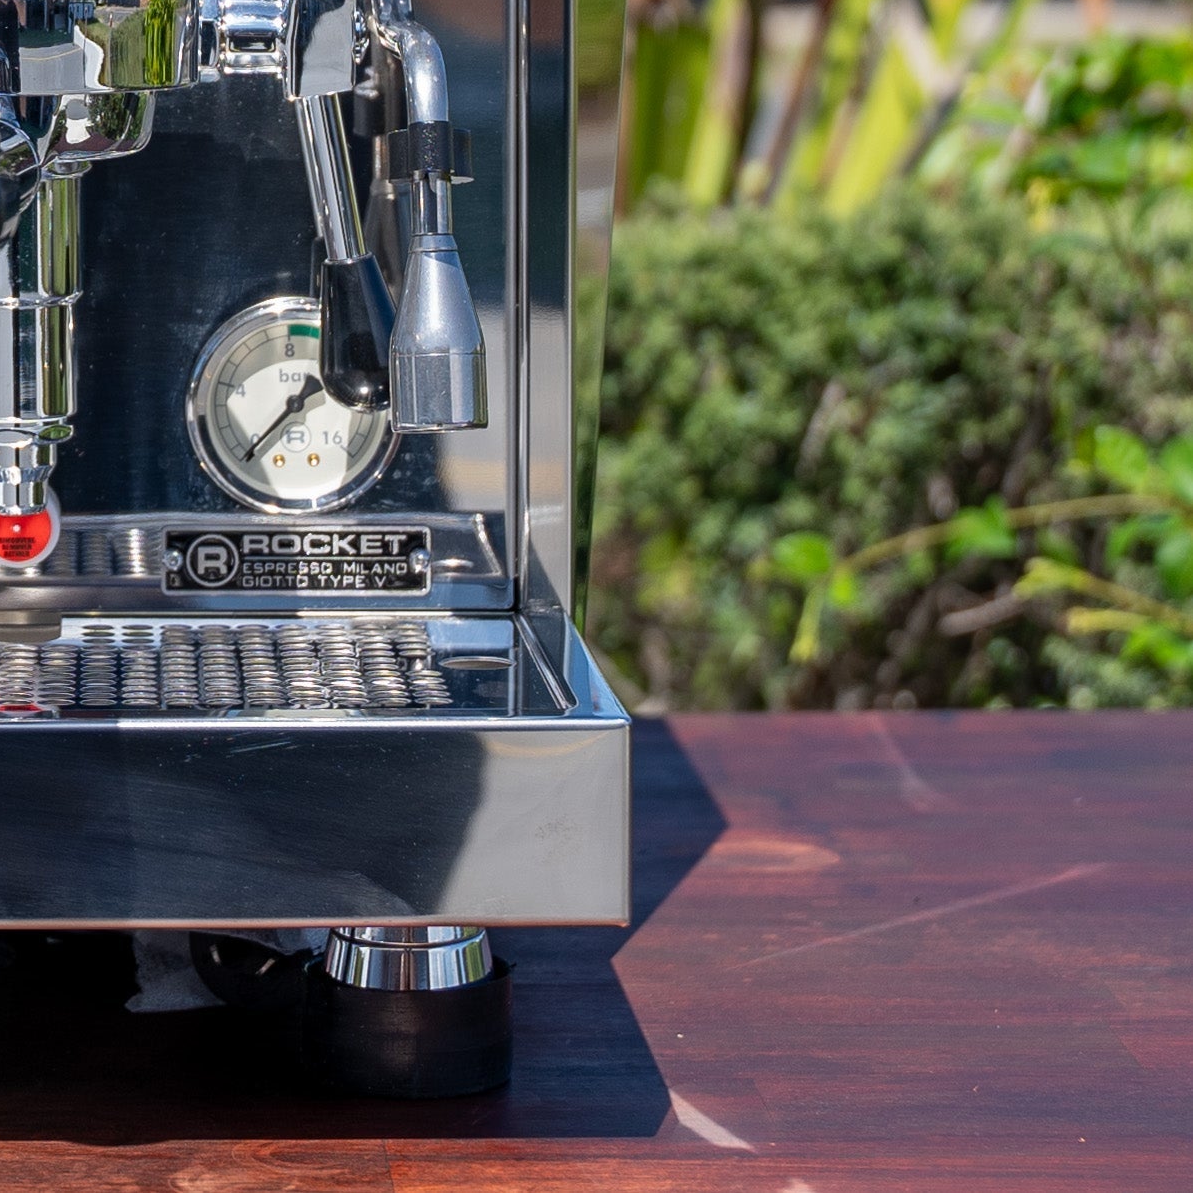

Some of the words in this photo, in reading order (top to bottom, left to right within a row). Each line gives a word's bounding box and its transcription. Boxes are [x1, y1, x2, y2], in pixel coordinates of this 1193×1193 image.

[284, 343, 295, 357] 8
[236, 384, 246, 398] 4
[322, 431, 343, 445] 16
[242, 533, 407, 555] ROCKET
[197, 545, 228, 575] R
[242, 562, 333, 575] ESPRESSO
[343, 562, 408, 575] MILANO
[242, 575, 309, 588] GIOTTO
[318, 575, 366, 588] TYPE
[374, 575, 387, 588] V
